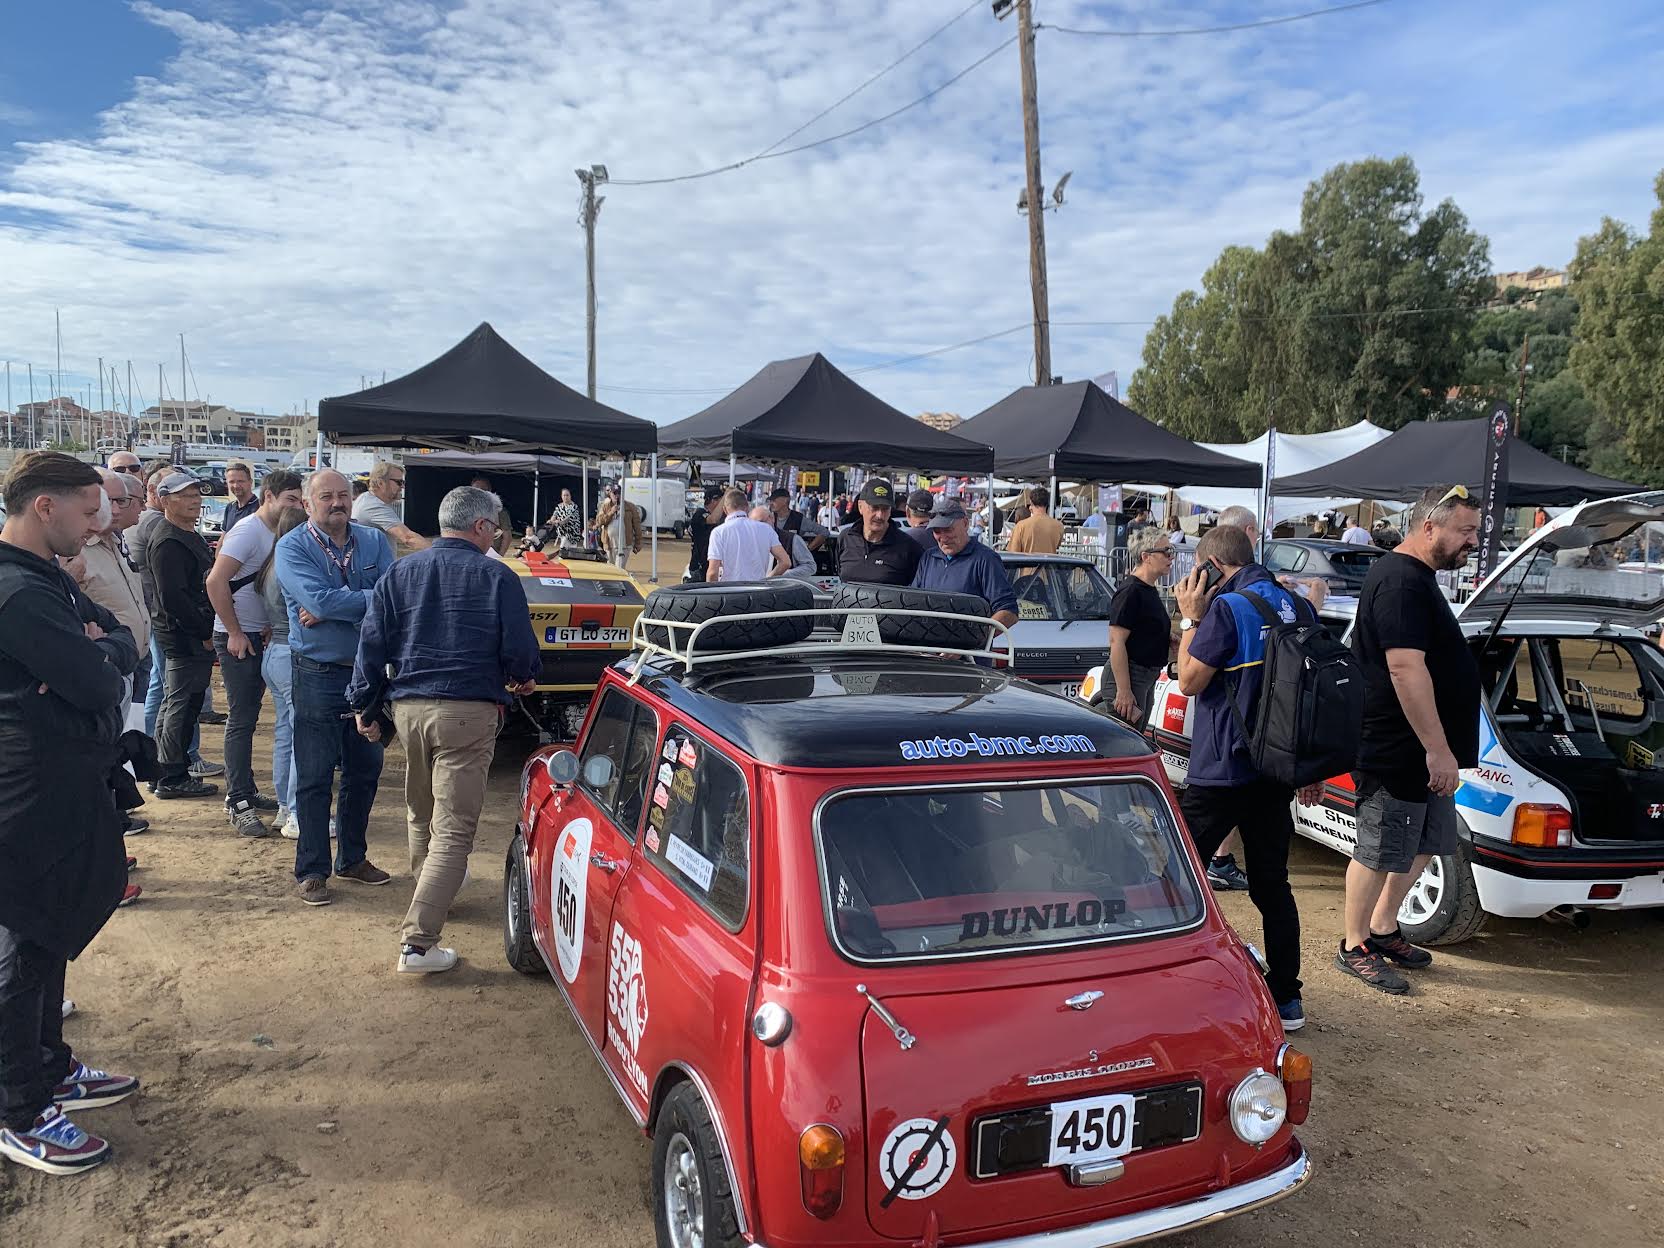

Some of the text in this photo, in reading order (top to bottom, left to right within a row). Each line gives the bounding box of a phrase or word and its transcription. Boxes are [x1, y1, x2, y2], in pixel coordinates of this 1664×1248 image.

[560, 629, 578, 641] GT
[602, 628, 629, 641] 37H
[849, 616, 874, 625] AUTO
[847, 630, 875, 643] BMC
[899, 732, 1097, 761] auto-bmc.com
[1297, 815, 1358, 845] MICHELIN
[1324, 808, 1358, 830] She
[556, 876, 577, 947] 450
[958, 899, 1127, 943] DUNLOP
[1089, 1049, 1099, 1062] S
[1028, 1056, 1155, 1086] MORRIS COOPER
[1056, 1104, 1128, 1155] 450
